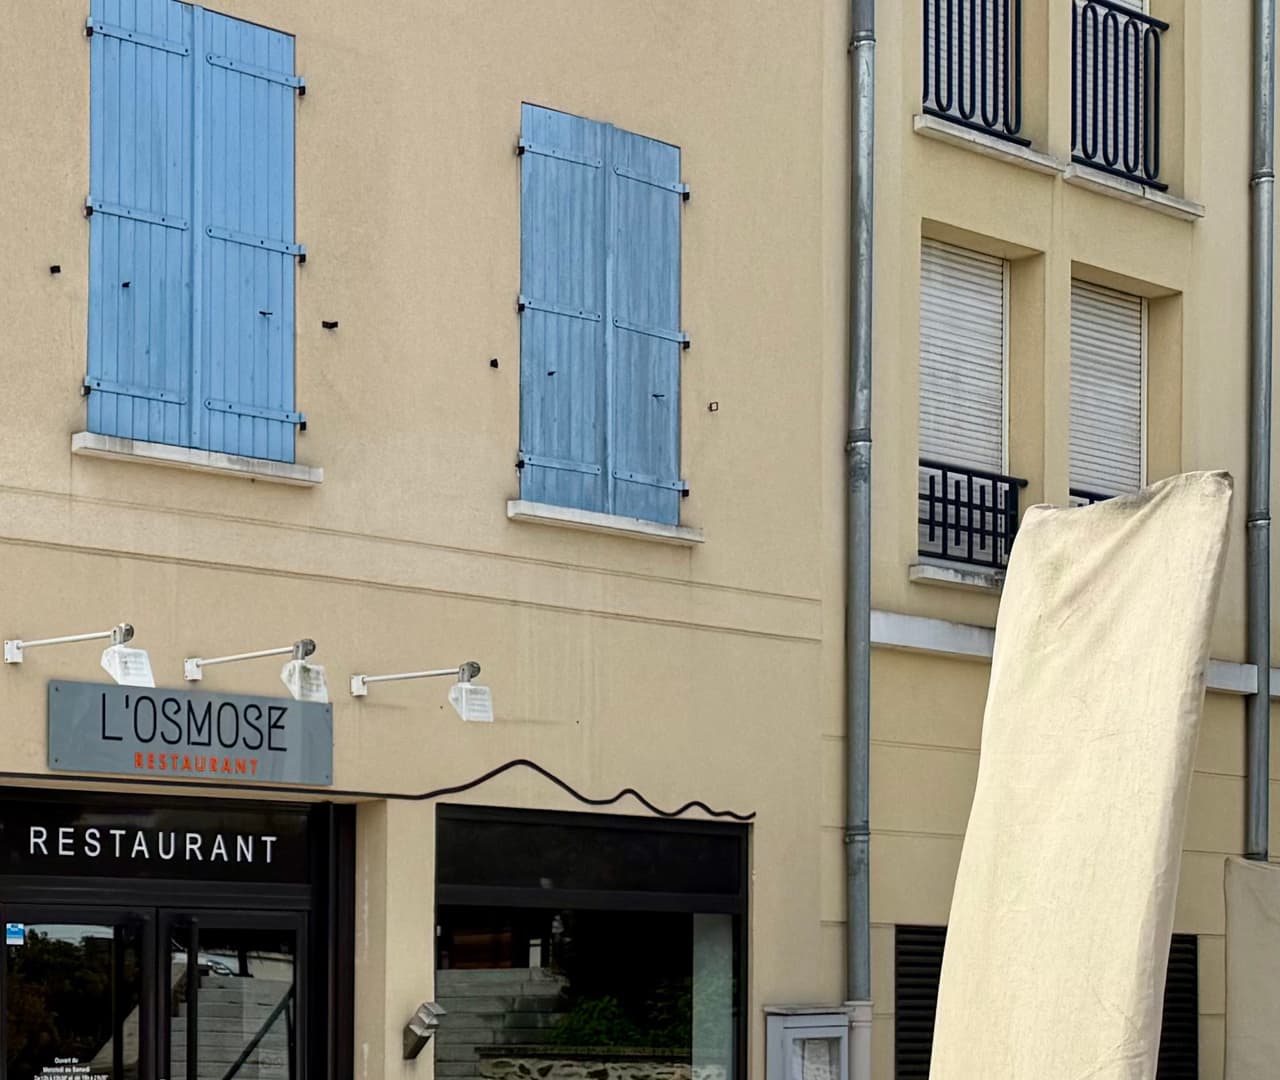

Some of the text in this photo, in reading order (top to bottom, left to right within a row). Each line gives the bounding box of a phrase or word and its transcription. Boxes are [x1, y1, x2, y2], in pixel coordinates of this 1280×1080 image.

[102, 692, 288, 752] L'OSMOSE
[134, 752, 258, 775] RESTAURANT
[29, 826, 277, 863] RESTAURANT
